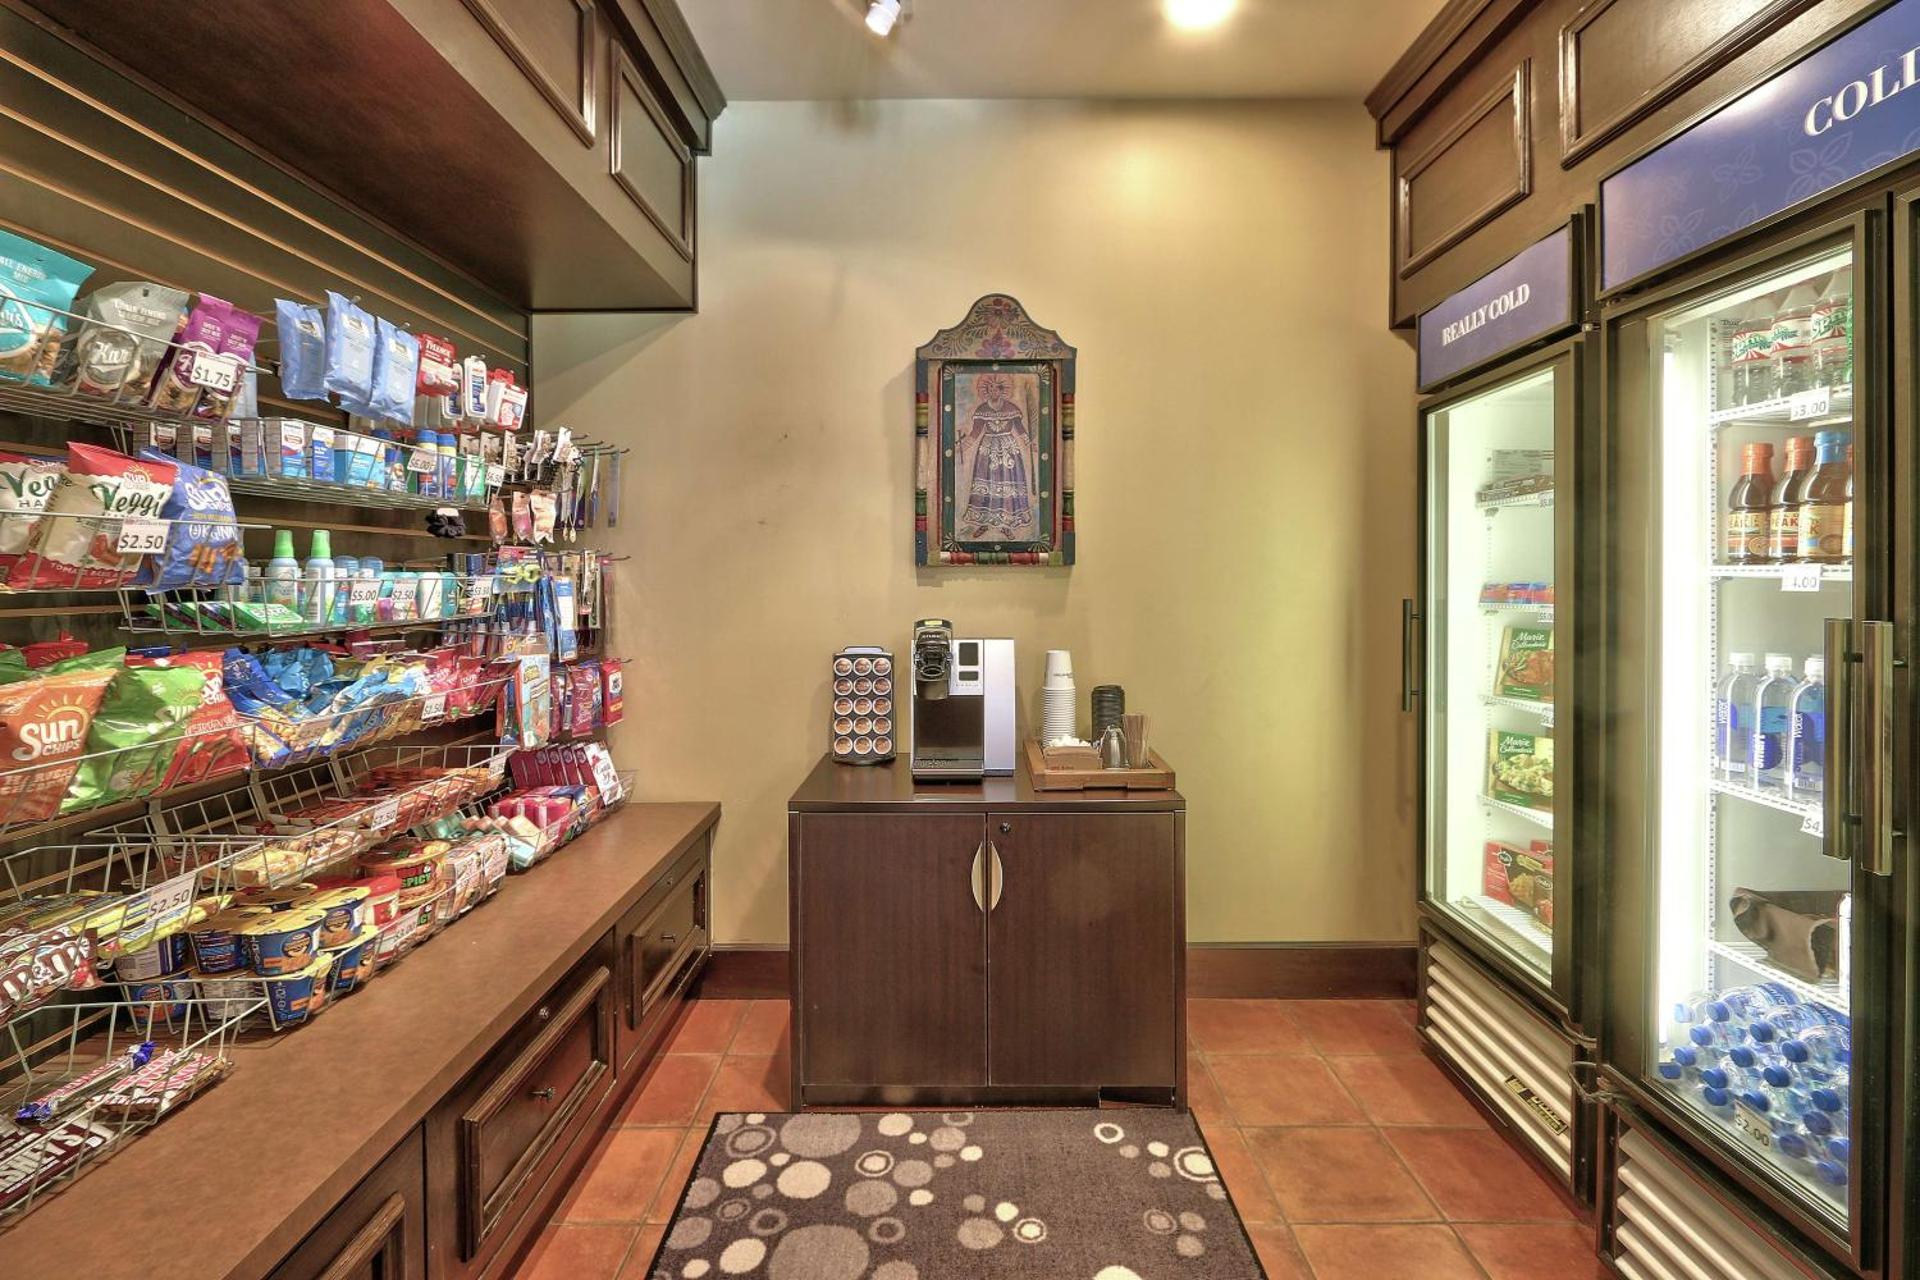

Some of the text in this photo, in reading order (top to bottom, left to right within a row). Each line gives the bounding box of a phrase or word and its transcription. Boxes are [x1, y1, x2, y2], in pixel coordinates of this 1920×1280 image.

[1441, 283, 1530, 347] REALLY COLD
[193, 366, 231, 388] $1.75
[119, 532, 164, 550] $2.50
[12, 719, 80, 761] Sun
[42, 740, 80, 756] CHIPS
[149, 889, 190, 917] $2.50
